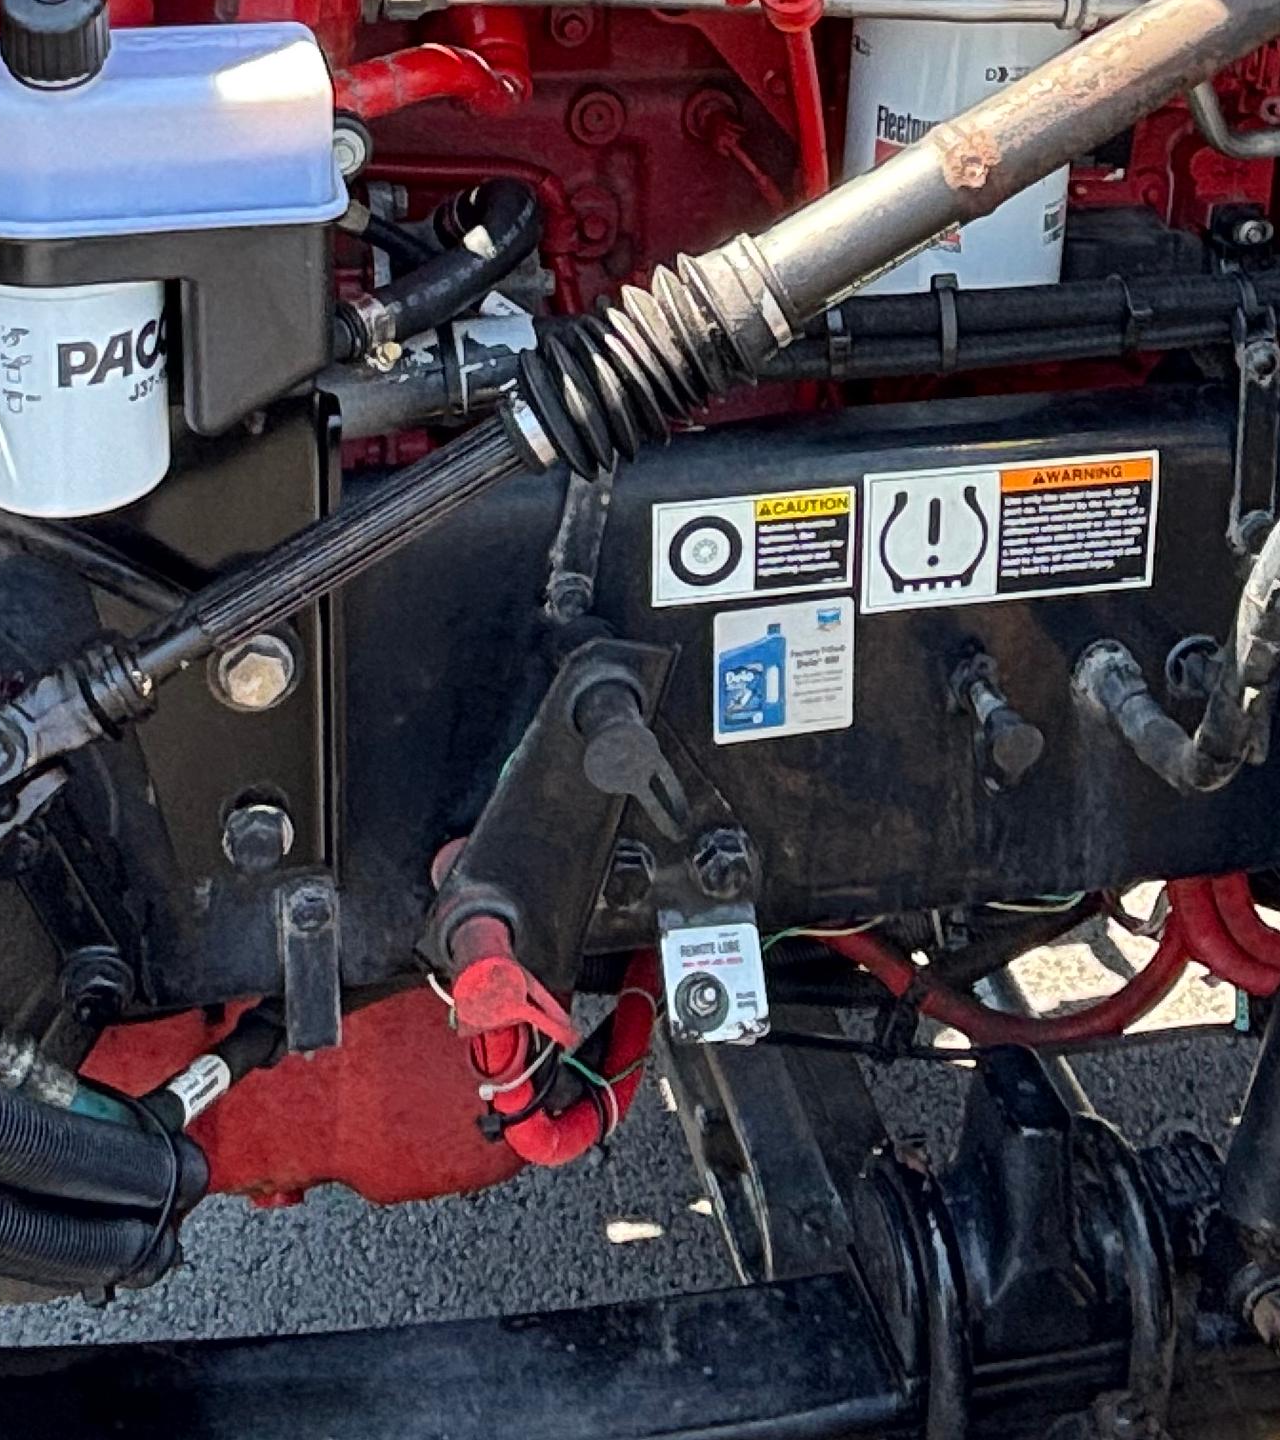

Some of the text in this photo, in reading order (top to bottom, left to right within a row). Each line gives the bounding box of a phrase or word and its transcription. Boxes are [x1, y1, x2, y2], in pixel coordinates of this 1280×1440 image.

[1045, 465, 1122, 483] WARNING
[773, 497, 849, 515] CAUTION
[725, 670, 754, 685] Delo
